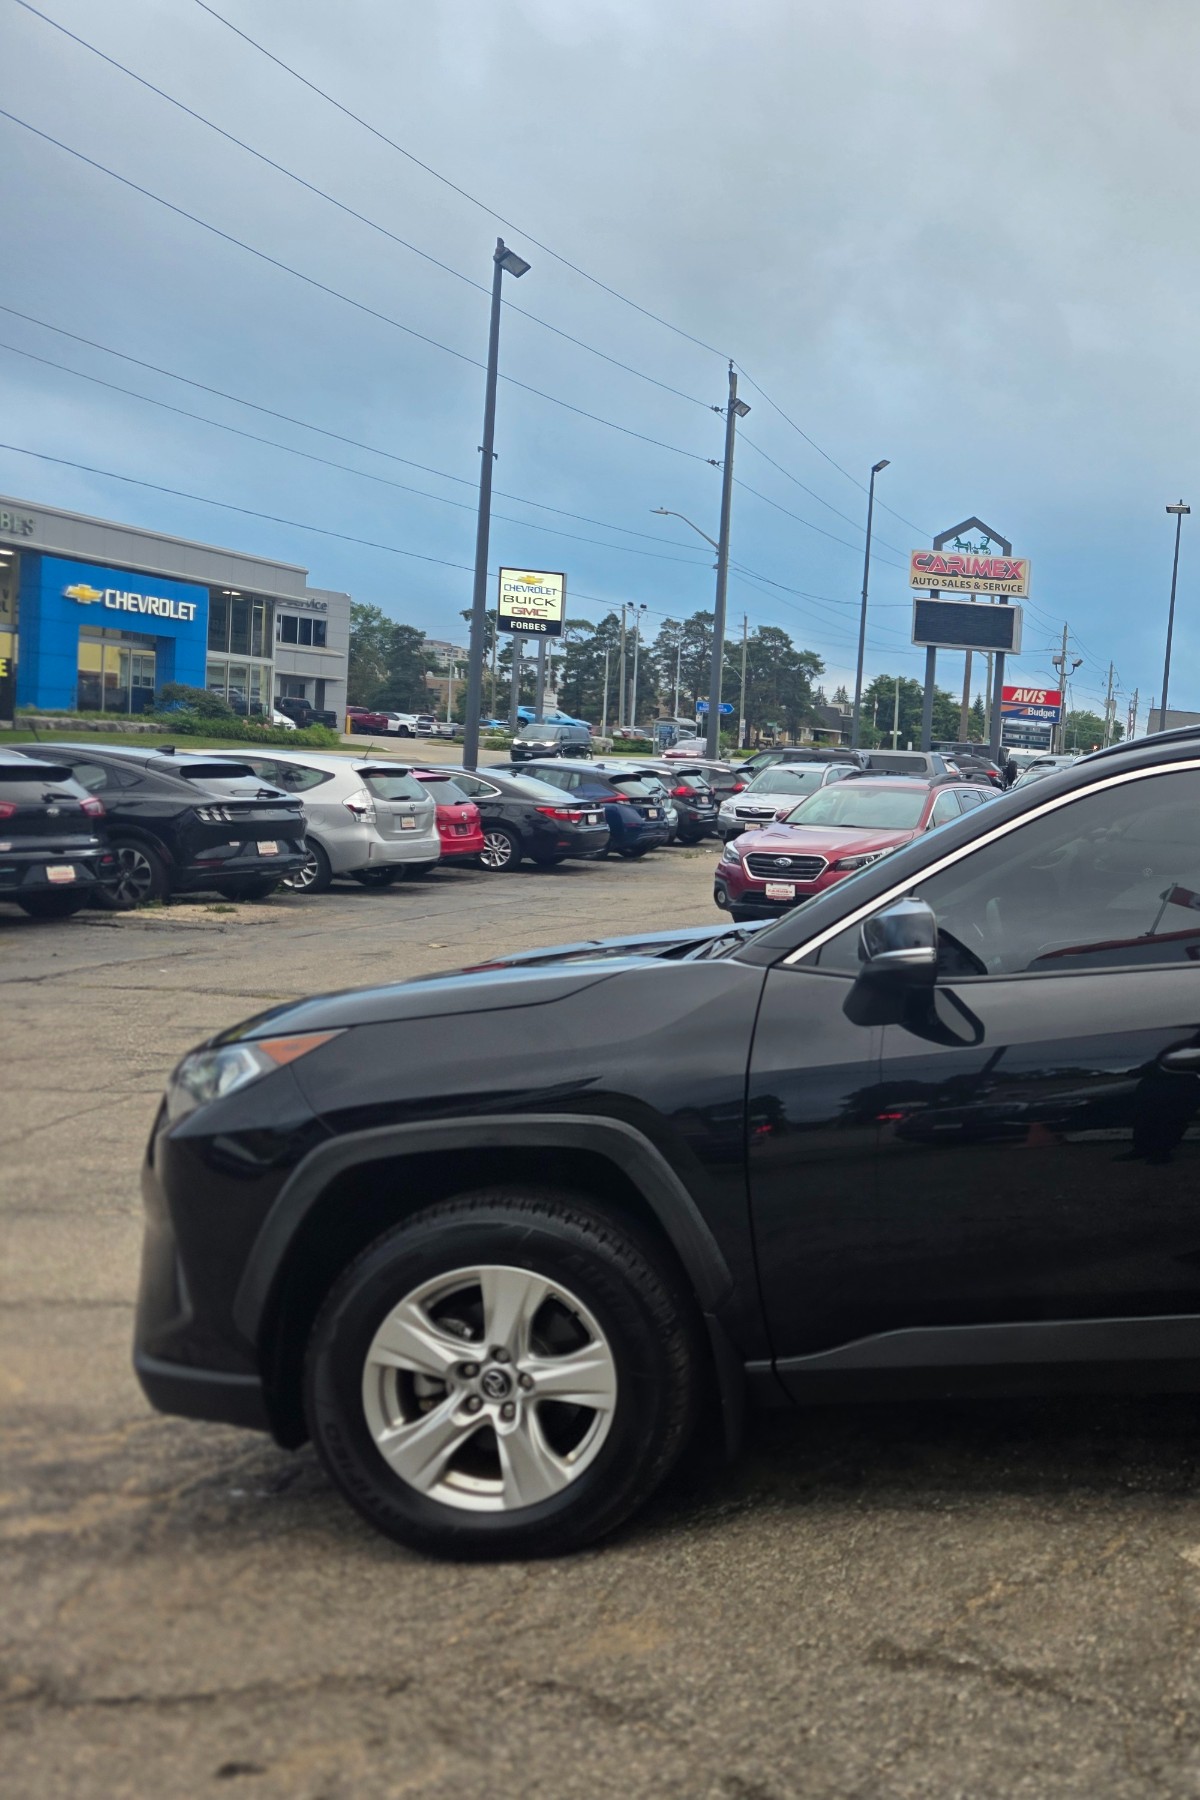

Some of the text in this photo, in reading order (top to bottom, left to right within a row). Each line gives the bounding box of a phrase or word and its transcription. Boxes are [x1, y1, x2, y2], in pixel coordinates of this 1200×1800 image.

[912, 552, 1025, 579] CARIMEX
[504, 584, 557, 595] CHEVROLET
[912, 576, 1023, 593] AUTO SALES & SERVICE
[105, 588, 196, 621] CHEVROLET
[503, 595, 556, 607] BUICK
[511, 606, 548, 617] GMC
[510, 621, 547, 631] FORBES
[1011, 689, 1047, 703] AVIS
[1027, 707, 1056, 718] Budget
